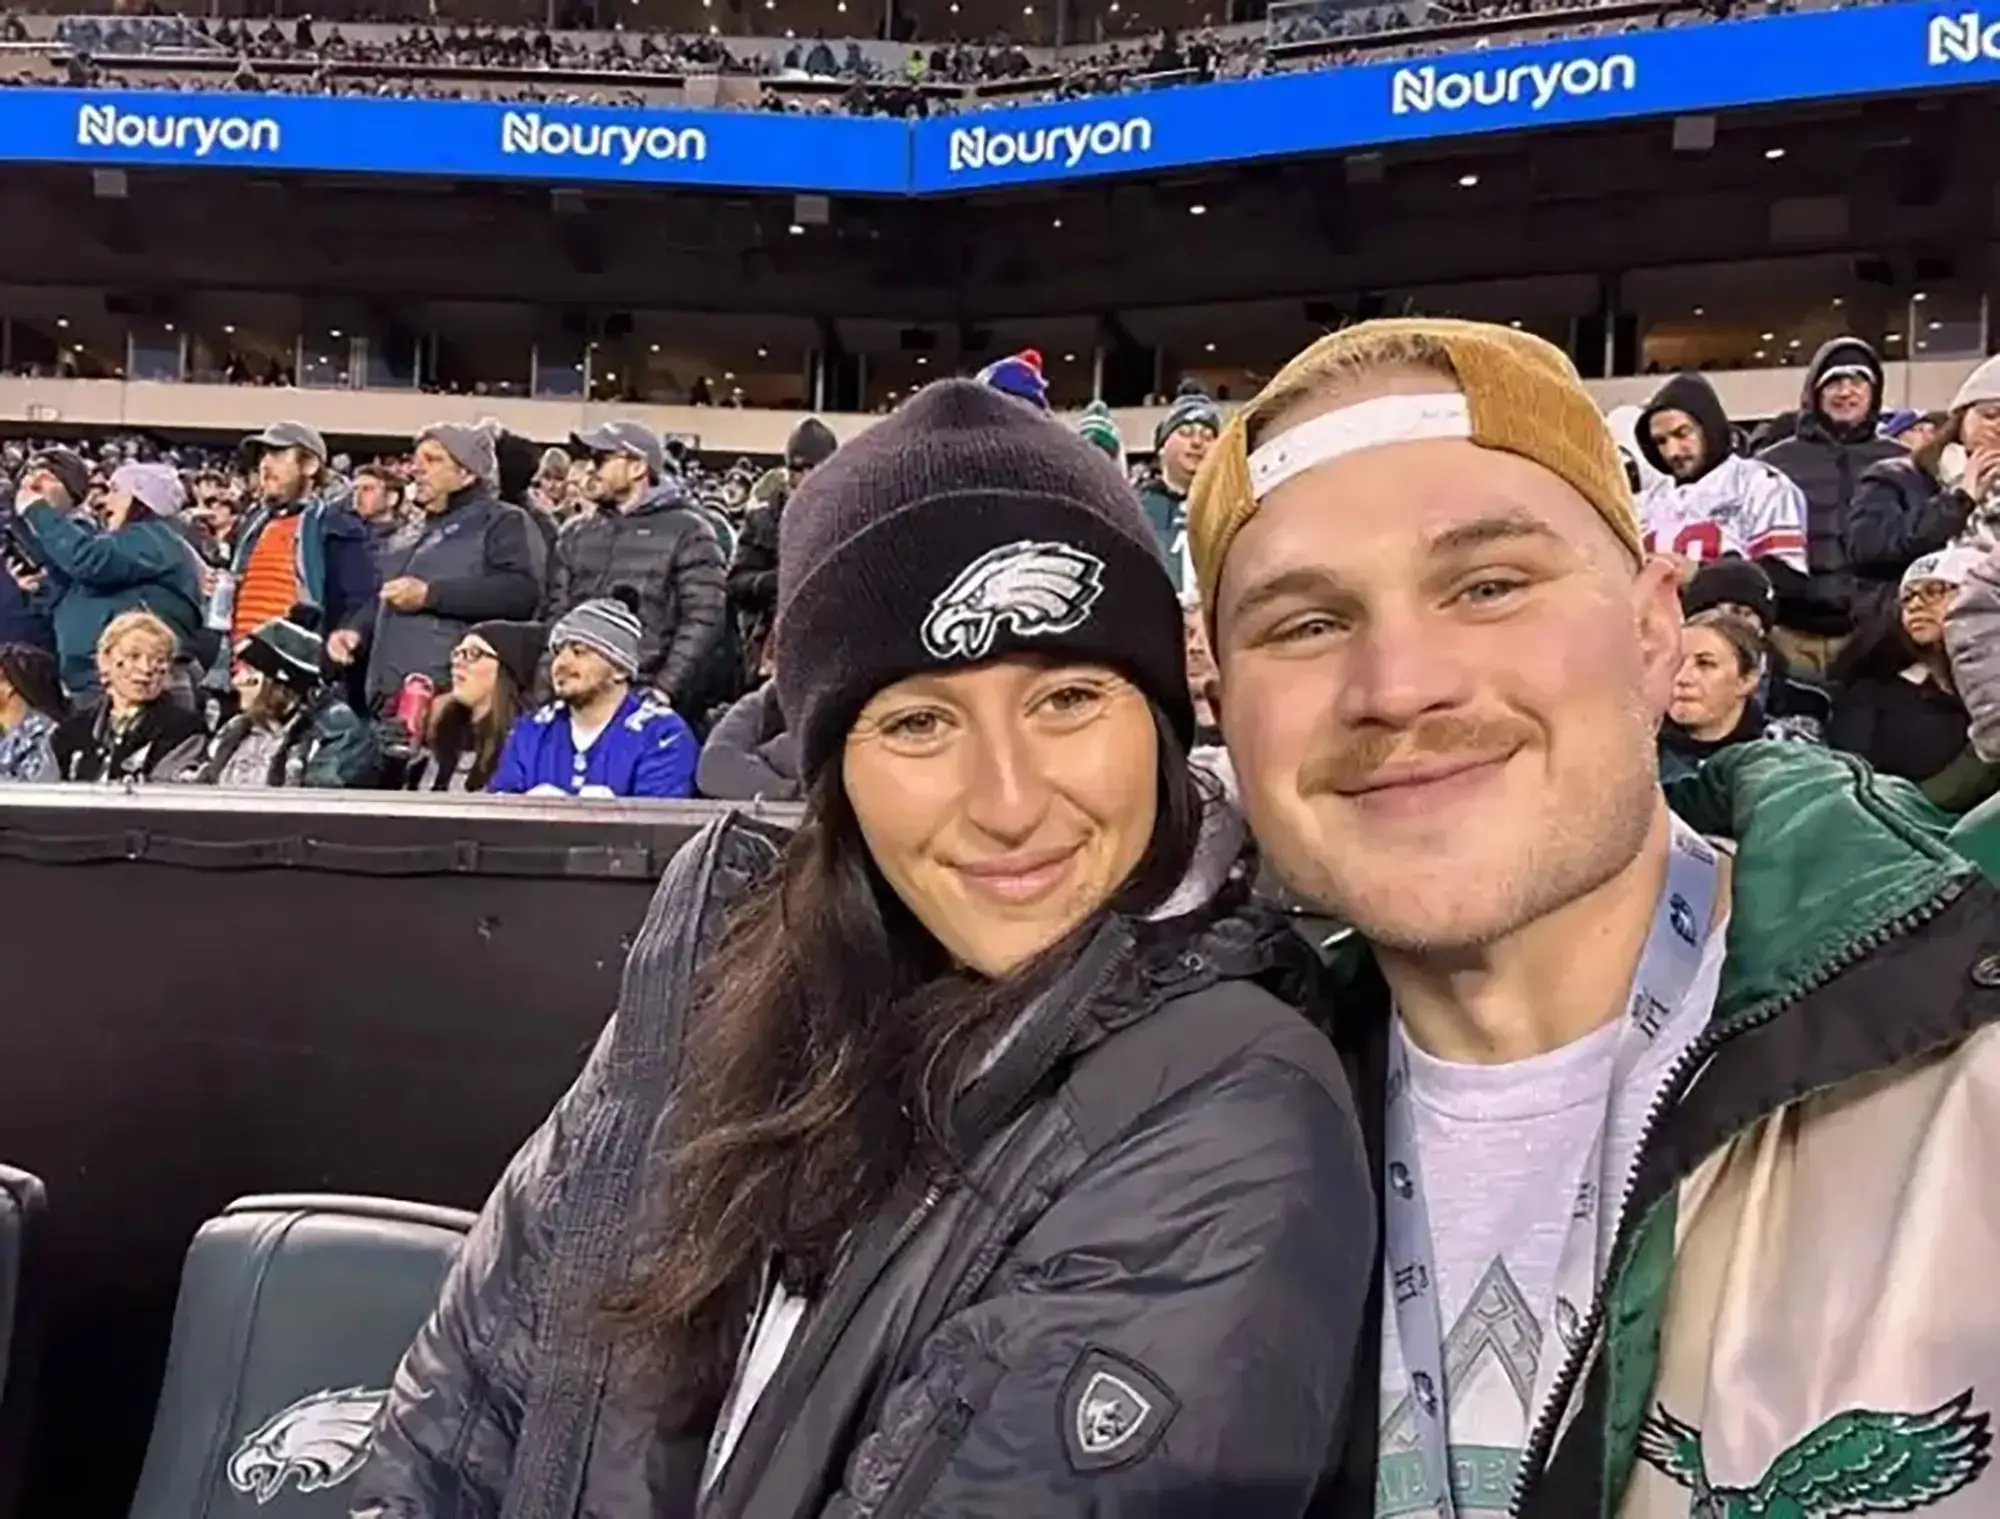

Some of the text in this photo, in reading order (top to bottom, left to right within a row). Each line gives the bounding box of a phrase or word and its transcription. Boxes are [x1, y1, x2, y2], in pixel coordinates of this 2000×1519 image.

[1392, 54, 1636, 114] Nouryon
[77, 104, 279, 157] Nouryon
[502, 111, 706, 165] Nouryon
[950, 117, 1152, 171] Nouryon
